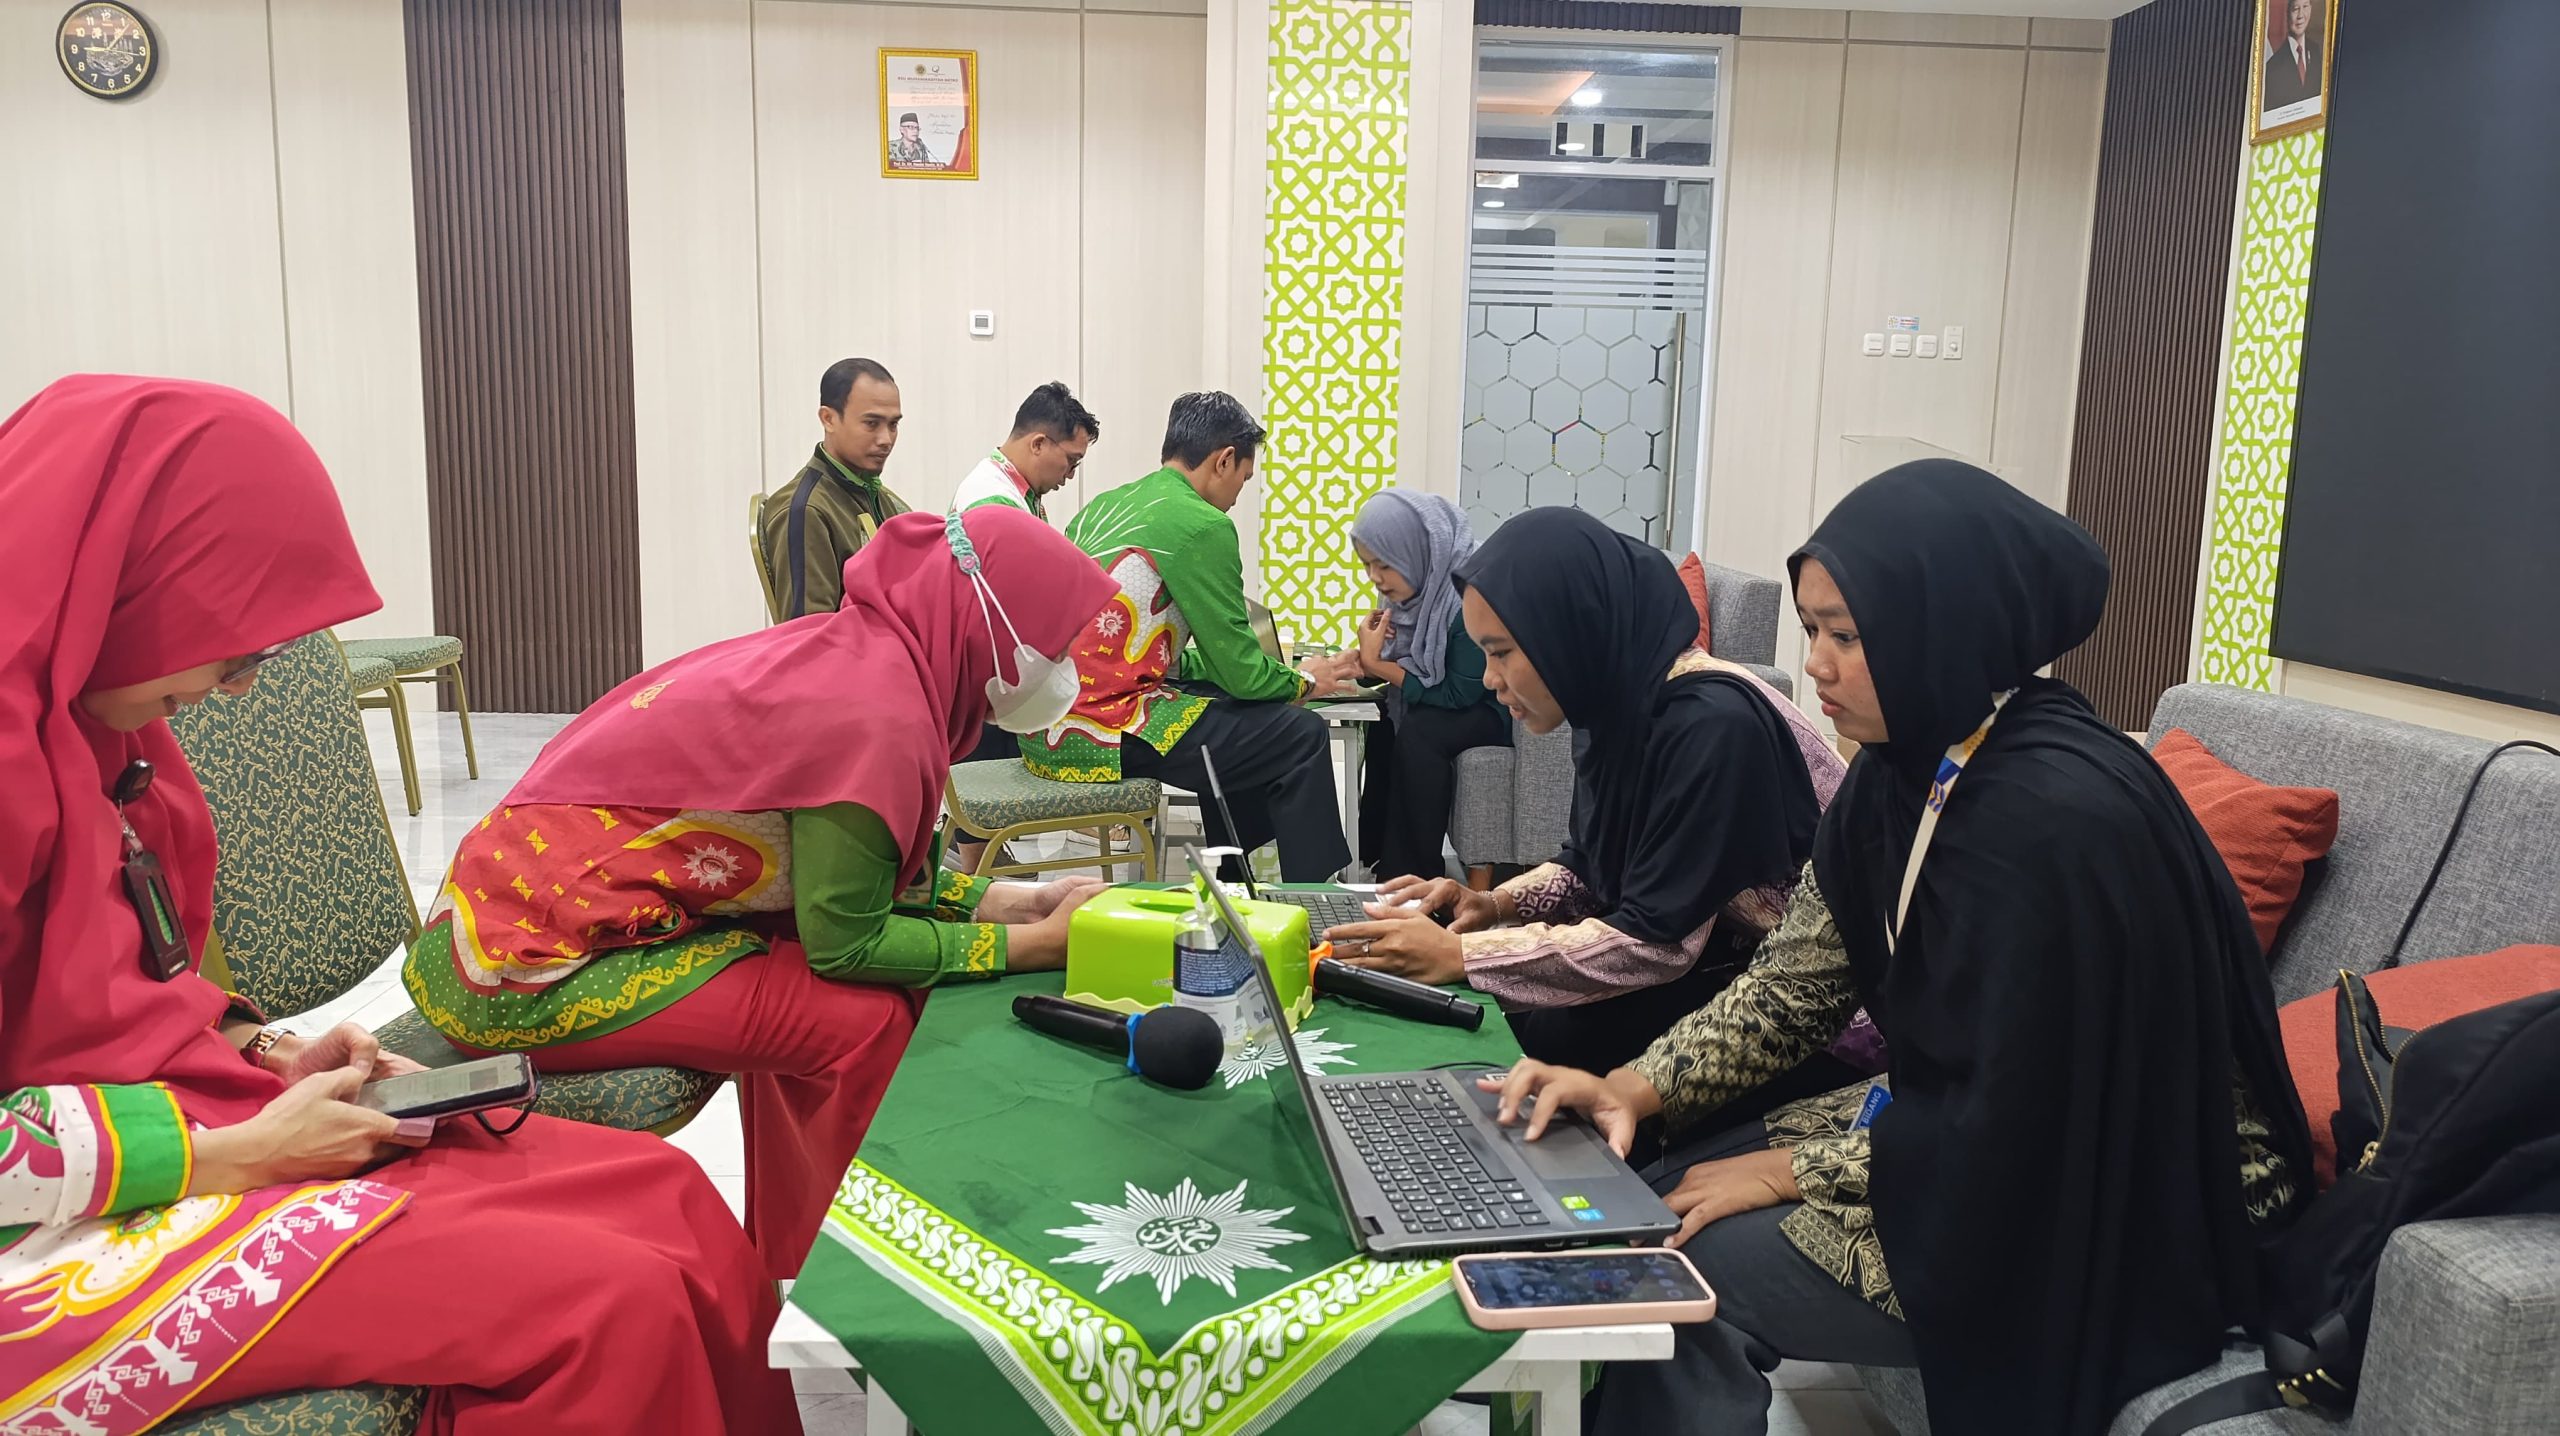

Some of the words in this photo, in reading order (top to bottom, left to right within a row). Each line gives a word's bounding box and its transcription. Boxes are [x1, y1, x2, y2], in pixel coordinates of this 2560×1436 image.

[86, 16, 95, 26] 11
[101, 12, 111, 21] 12
[120, 18, 125, 26] 1
[76, 27, 85, 37] 10
[132, 29, 140, 39] 2
[71, 44, 78, 54] 9
[139, 46, 146, 56] 3
[78, 62, 85, 71] 8
[135, 63, 141, 72] 4
[91, 73, 98, 83] 7
[124, 74, 131, 84] 5
[107, 79, 115, 88] 6
[1862, 1091, 1882, 1125] BIDANG
